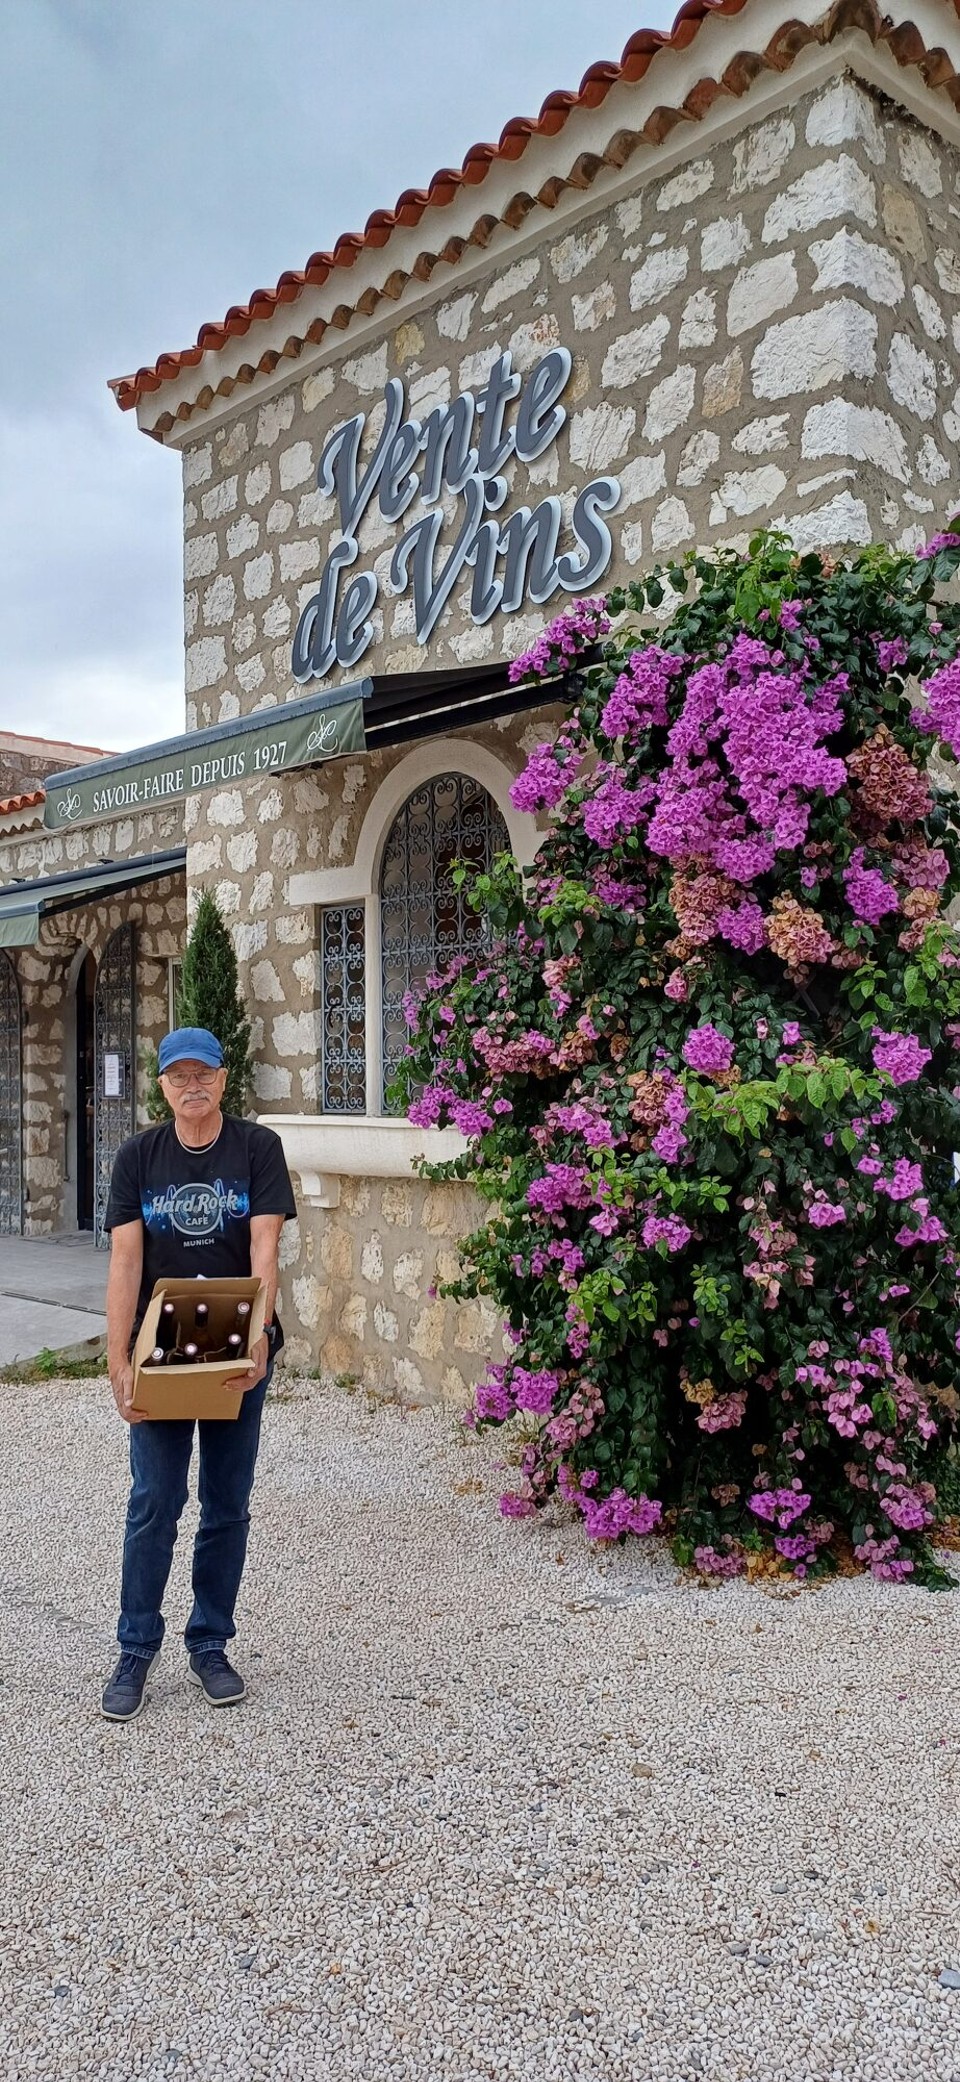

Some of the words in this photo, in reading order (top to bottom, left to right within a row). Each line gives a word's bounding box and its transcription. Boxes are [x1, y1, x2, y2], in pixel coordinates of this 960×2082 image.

[317, 346, 572, 538] Vente
[291, 536, 378, 684] de
[390, 475, 622, 645] Vins
[93, 770, 184, 812] SAVOIR-FAIRE
[191, 752, 246, 787] DEPUIS
[253, 740, 288, 772] 1927
[152, 1193, 197, 1215] Hard
[197, 1189, 238, 1215] Rock
[183, 1237, 215, 1248] MUNICH
